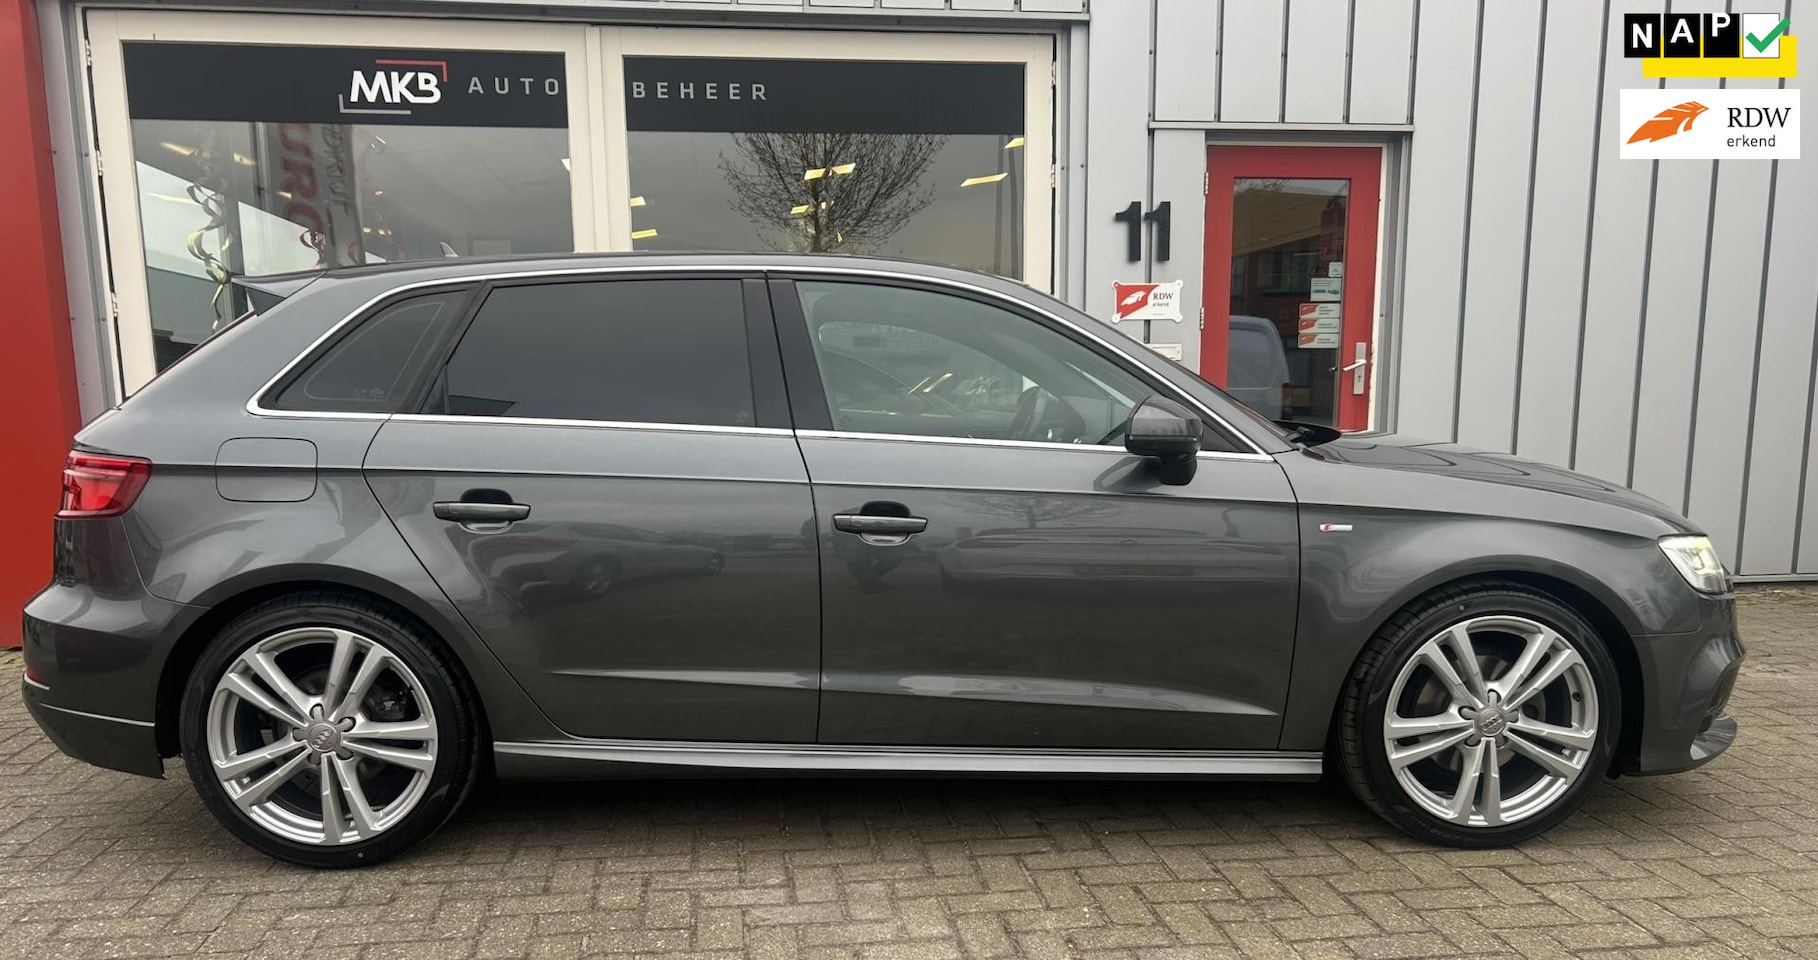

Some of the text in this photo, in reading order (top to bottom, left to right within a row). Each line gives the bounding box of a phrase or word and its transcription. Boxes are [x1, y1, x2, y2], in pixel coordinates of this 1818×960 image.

[350, 70, 767, 104] MKB AUTO BEHEER
[1114, 201, 1171, 262] 11
[1153, 292, 1174, 300] RDW
